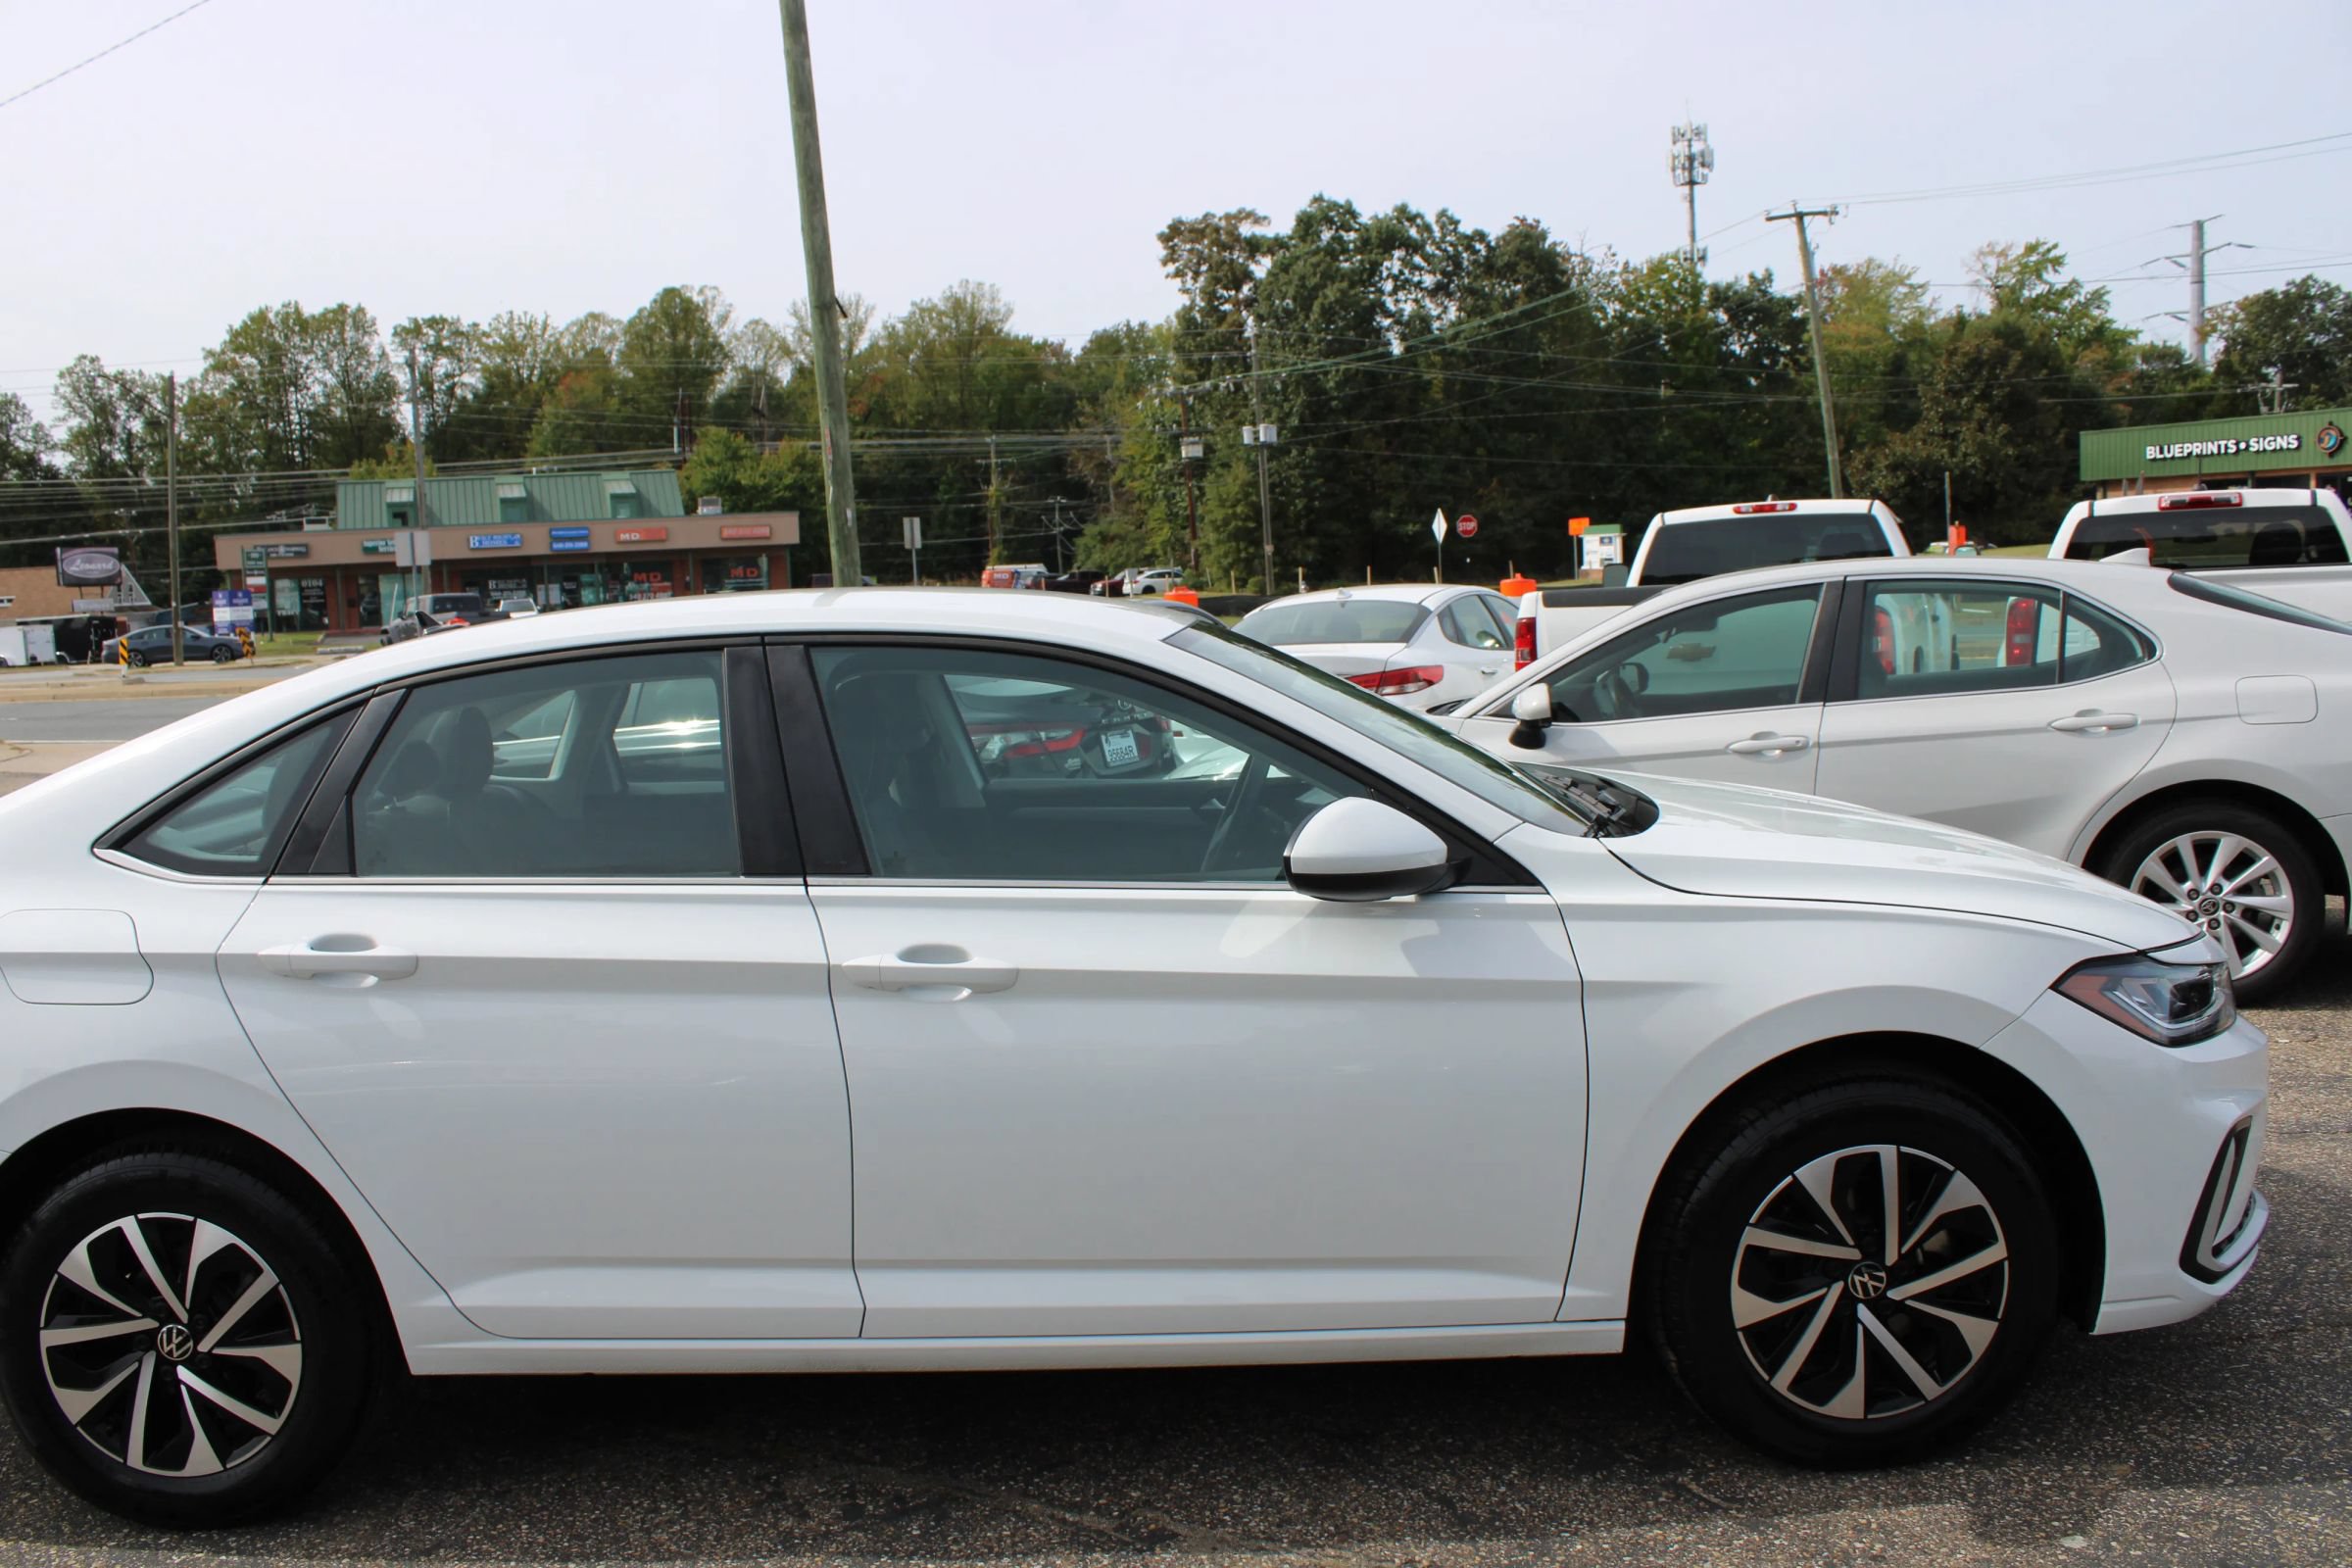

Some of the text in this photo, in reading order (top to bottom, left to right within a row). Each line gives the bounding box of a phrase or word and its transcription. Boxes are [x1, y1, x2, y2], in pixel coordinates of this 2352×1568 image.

[2145, 434, 2300, 461] BLUEPRINTS SIGNS
[1458, 526, 1475, 536] STOP
